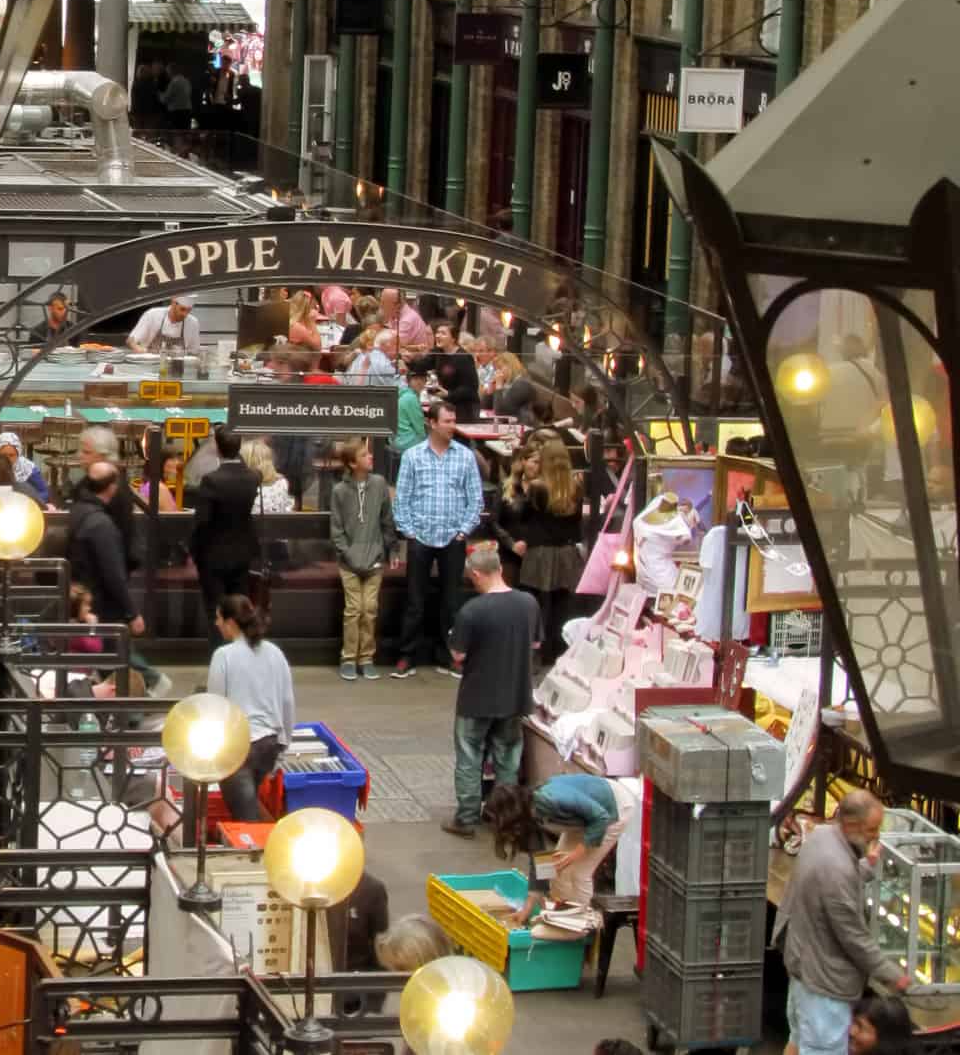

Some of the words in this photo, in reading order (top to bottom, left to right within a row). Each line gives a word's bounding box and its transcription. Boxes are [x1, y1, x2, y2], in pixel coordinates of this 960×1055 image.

[138, 235, 281, 290] APPLE
[315, 235, 523, 298] MARKET
[239, 403, 309, 416] Hand-made
[310, 404, 330, 416] Art
[331, 405, 342, 417] &
[343, 405, 385, 419] Design
